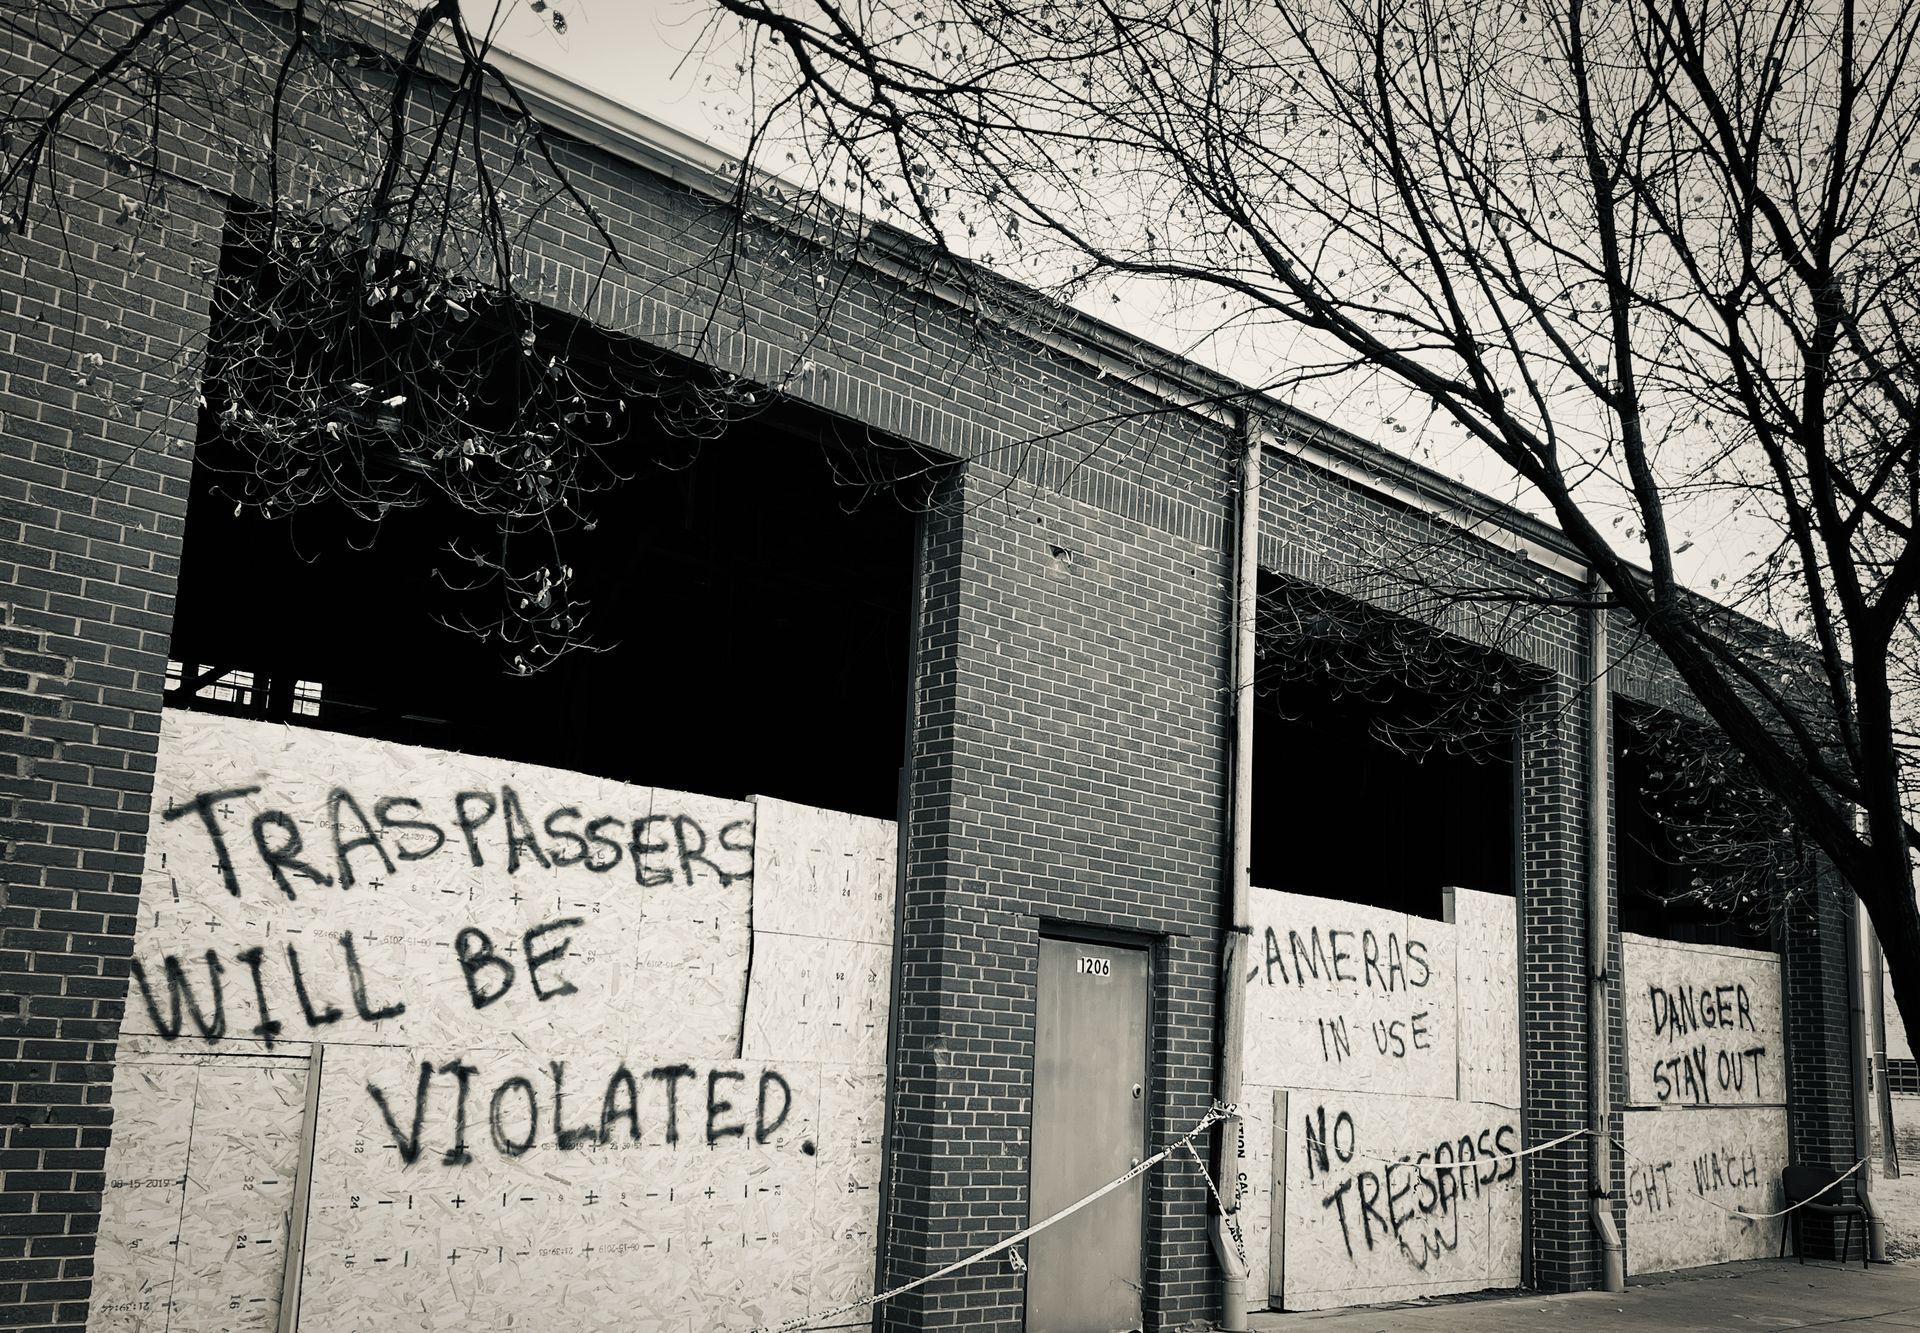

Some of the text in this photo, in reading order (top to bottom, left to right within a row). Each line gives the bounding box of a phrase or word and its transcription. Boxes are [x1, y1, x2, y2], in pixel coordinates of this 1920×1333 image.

[162, 784, 755, 901] TRASPASSERS
[131, 917, 585, 1050] WILL BE
[1081, 958, 1109, 976] 1206
[1318, 1011, 1430, 1062] IN USE
[1649, 983, 1756, 1043] DANGER
[1653, 1044, 1766, 1104] STAY OUT
[368, 1059, 816, 1165] VIOLATED.
[1305, 1104, 1355, 1180] NO
